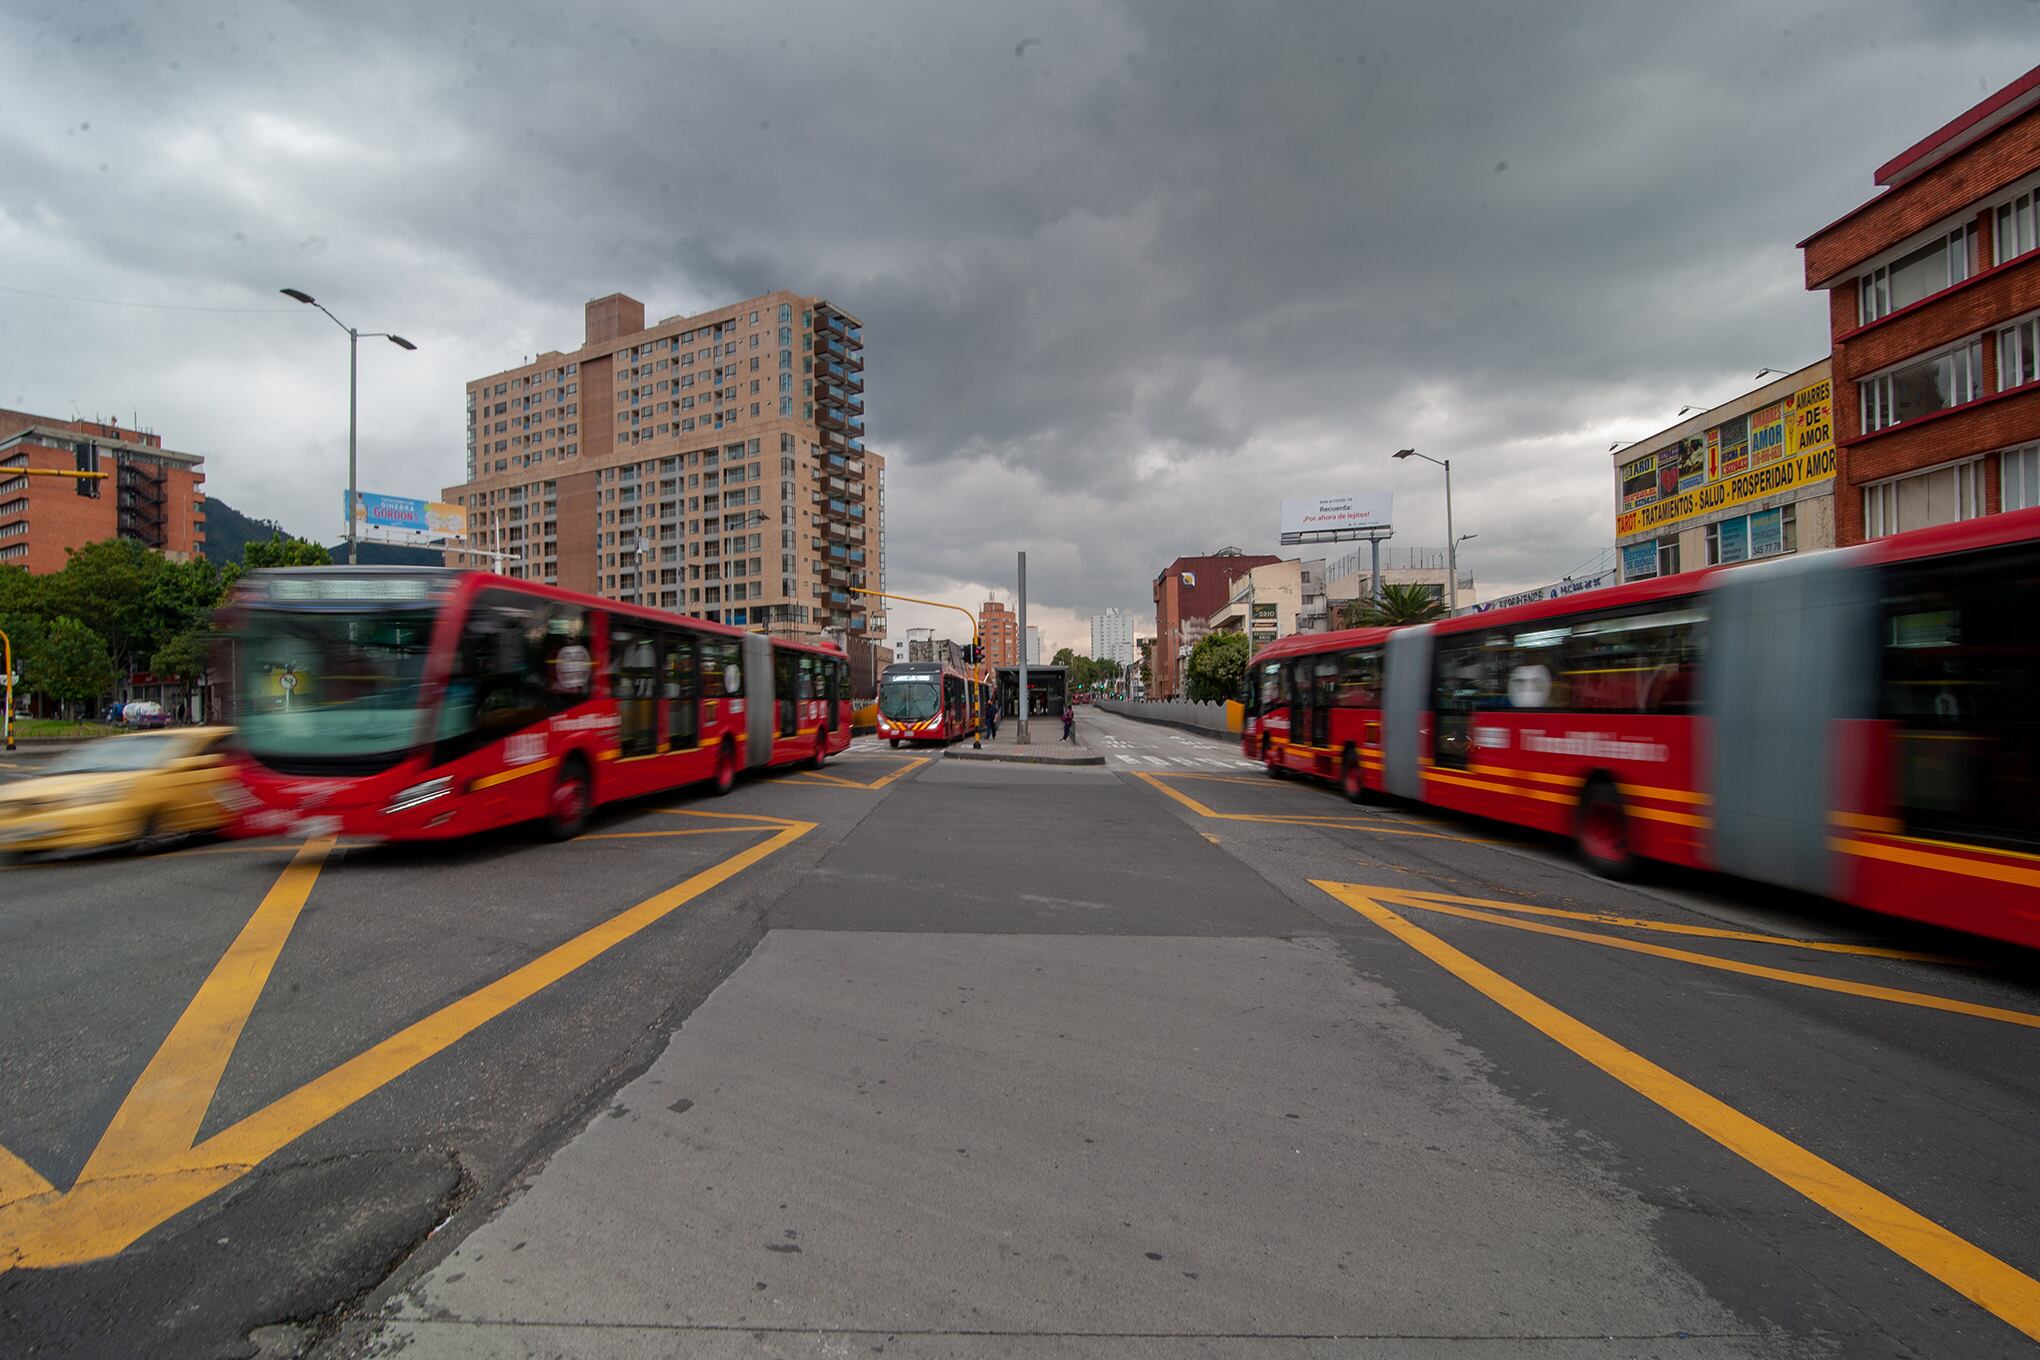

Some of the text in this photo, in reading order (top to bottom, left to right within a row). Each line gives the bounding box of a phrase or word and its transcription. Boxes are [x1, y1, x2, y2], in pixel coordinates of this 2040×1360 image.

[1797, 383, 1830, 410] AMARRES
[1753, 405, 1782, 429] AMARRES
[1806, 407, 1821, 427] DE
[1753, 423, 1782, 452] AMOR
[1799, 424, 1830, 450] AMOR
[1629, 456, 1655, 477] TAROT
[1617, 512, 1637, 534] TAROT
[1642, 494, 1694, 527] TRATAMIENTOS
[1700, 481, 1725, 510] SALUD
[1732, 462, 1794, 500] PROSPERIDAD
[1796, 459, 1803, 480] Y
[1806, 448, 1836, 479] AMOR
[381, 502, 415, 512] GINEBRA
[1318, 513, 1336, 521] ahora
[1347, 511, 1370, 520] lejitos!
[1320, 504, 1352, 513] Recuerda:
